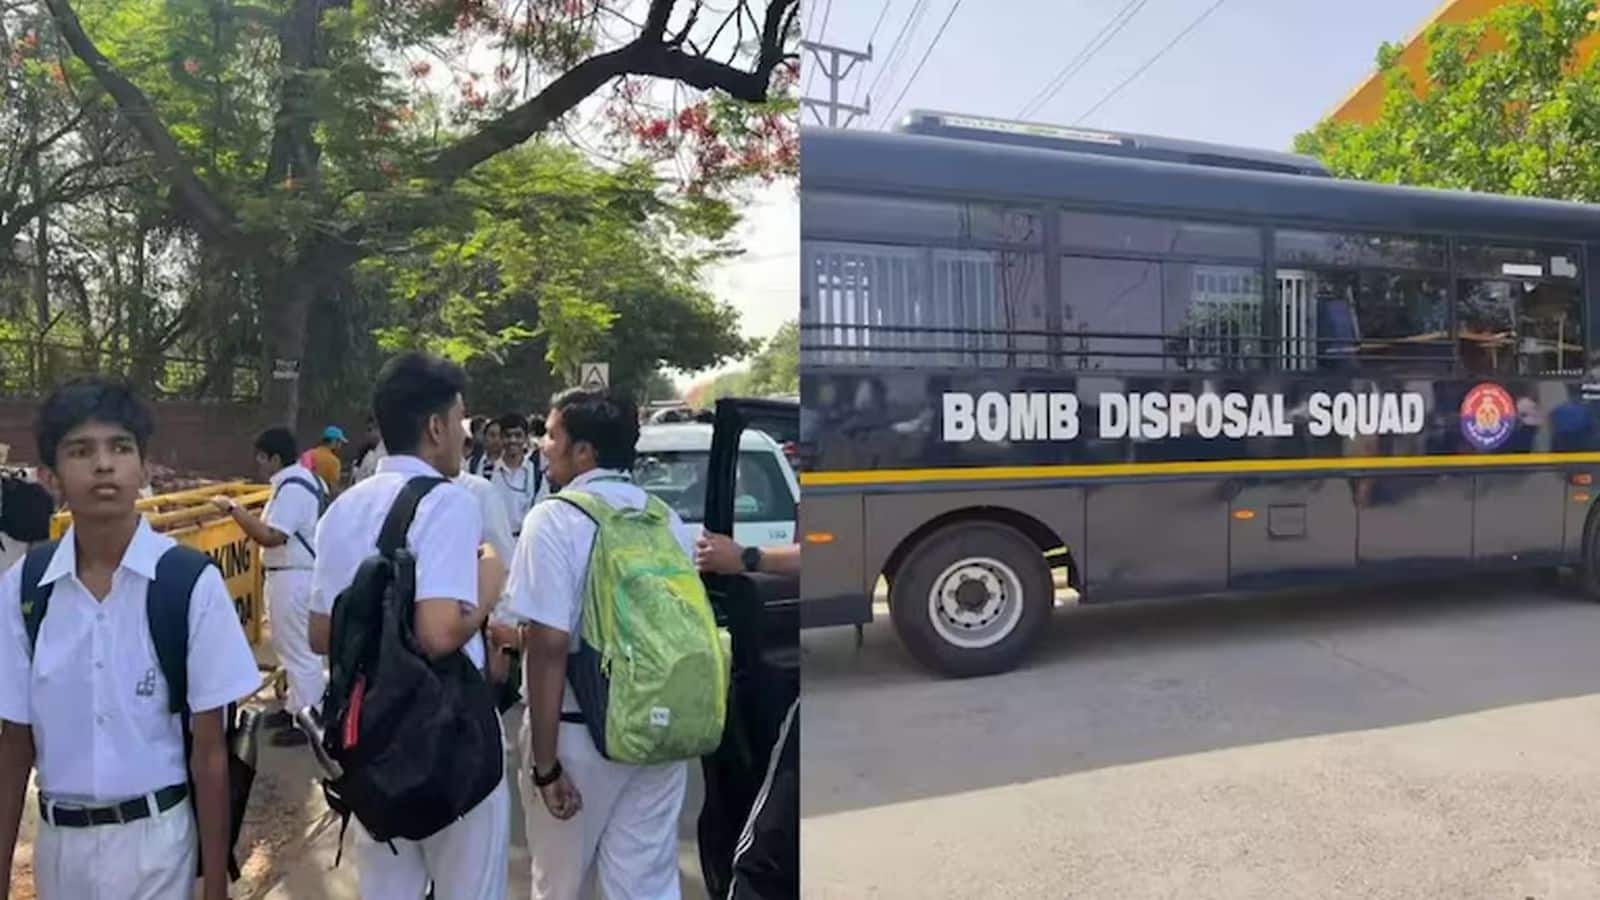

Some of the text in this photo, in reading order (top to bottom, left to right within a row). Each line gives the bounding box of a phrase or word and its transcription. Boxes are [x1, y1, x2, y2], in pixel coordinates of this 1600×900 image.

[943, 391, 1079, 442] BOMB
[1100, 391, 1293, 439] DISPOSAL
[1308, 391, 1424, 440] SQUAD
